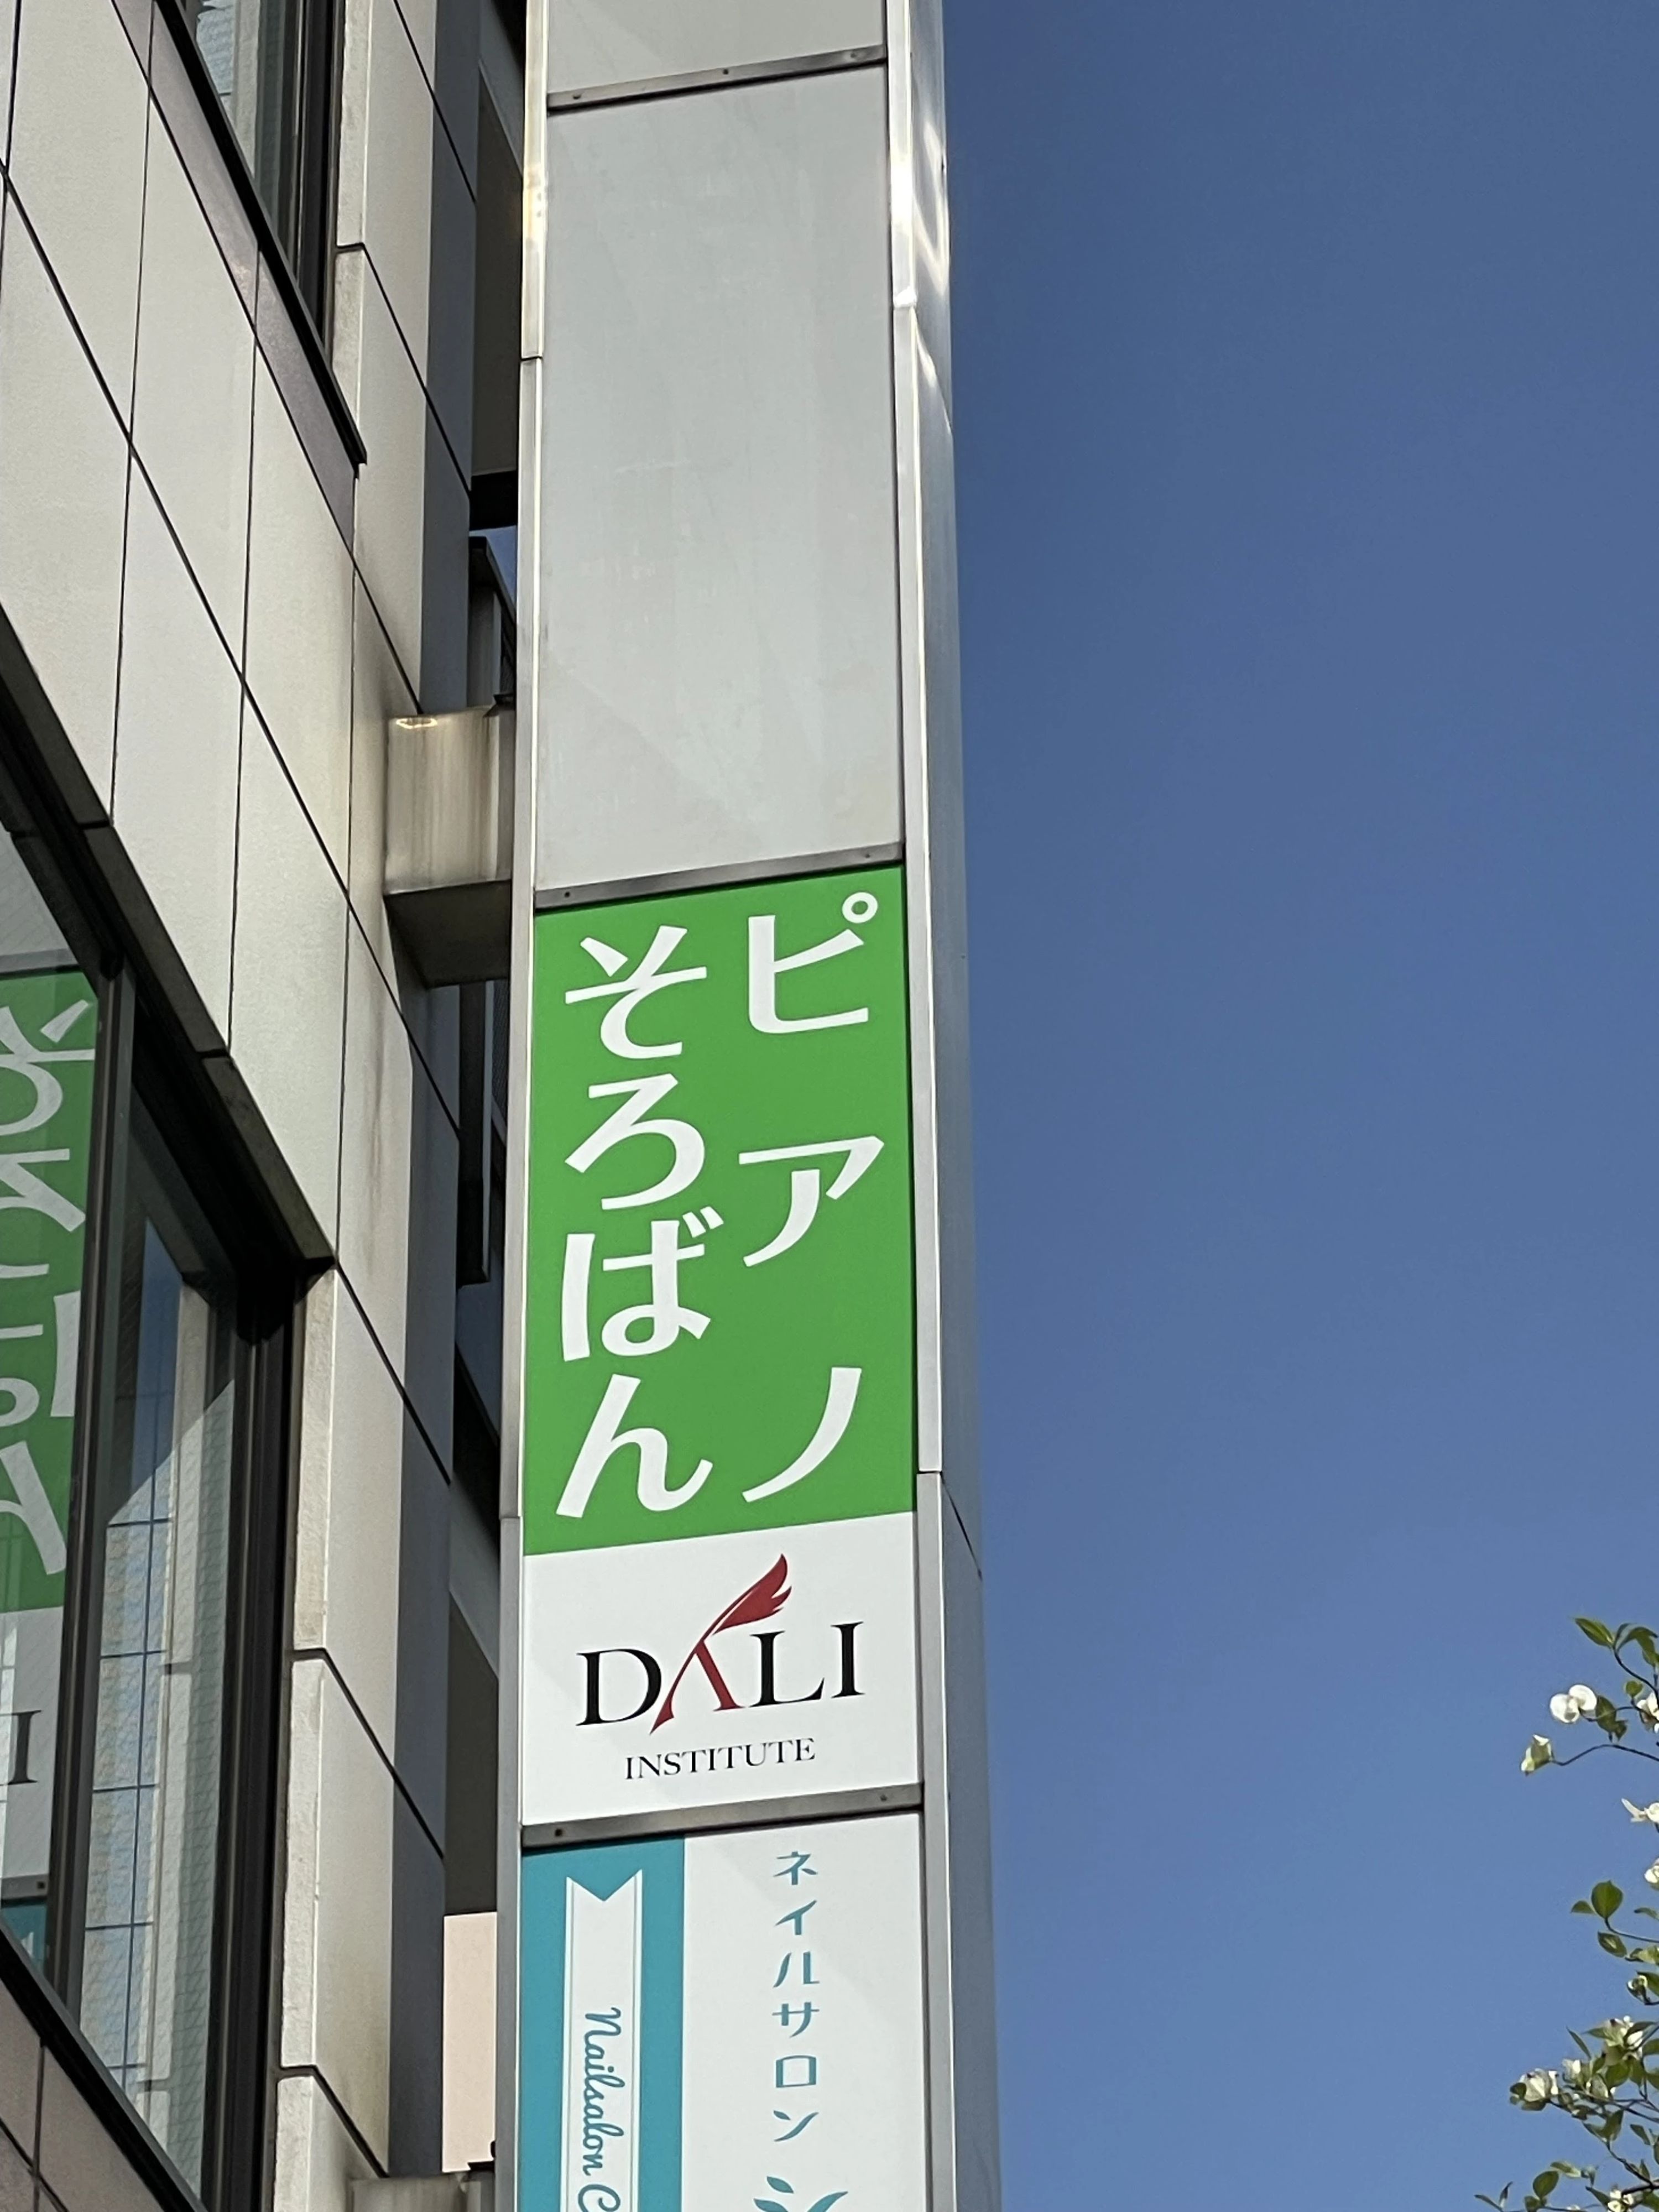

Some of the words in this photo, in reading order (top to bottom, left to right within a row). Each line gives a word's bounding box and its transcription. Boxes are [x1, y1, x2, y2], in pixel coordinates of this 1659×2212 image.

[555, 925, 724, 1519] そろばん
[738, 891, 885, 1503] ピアノ
[575, 1553, 864, 1735] DALI
[625, 1738, 816, 1780] INSTITUTE
[583, 2006, 625, 2177] Nailsalon
[772, 1850, 820, 2142] ネイルサロン
